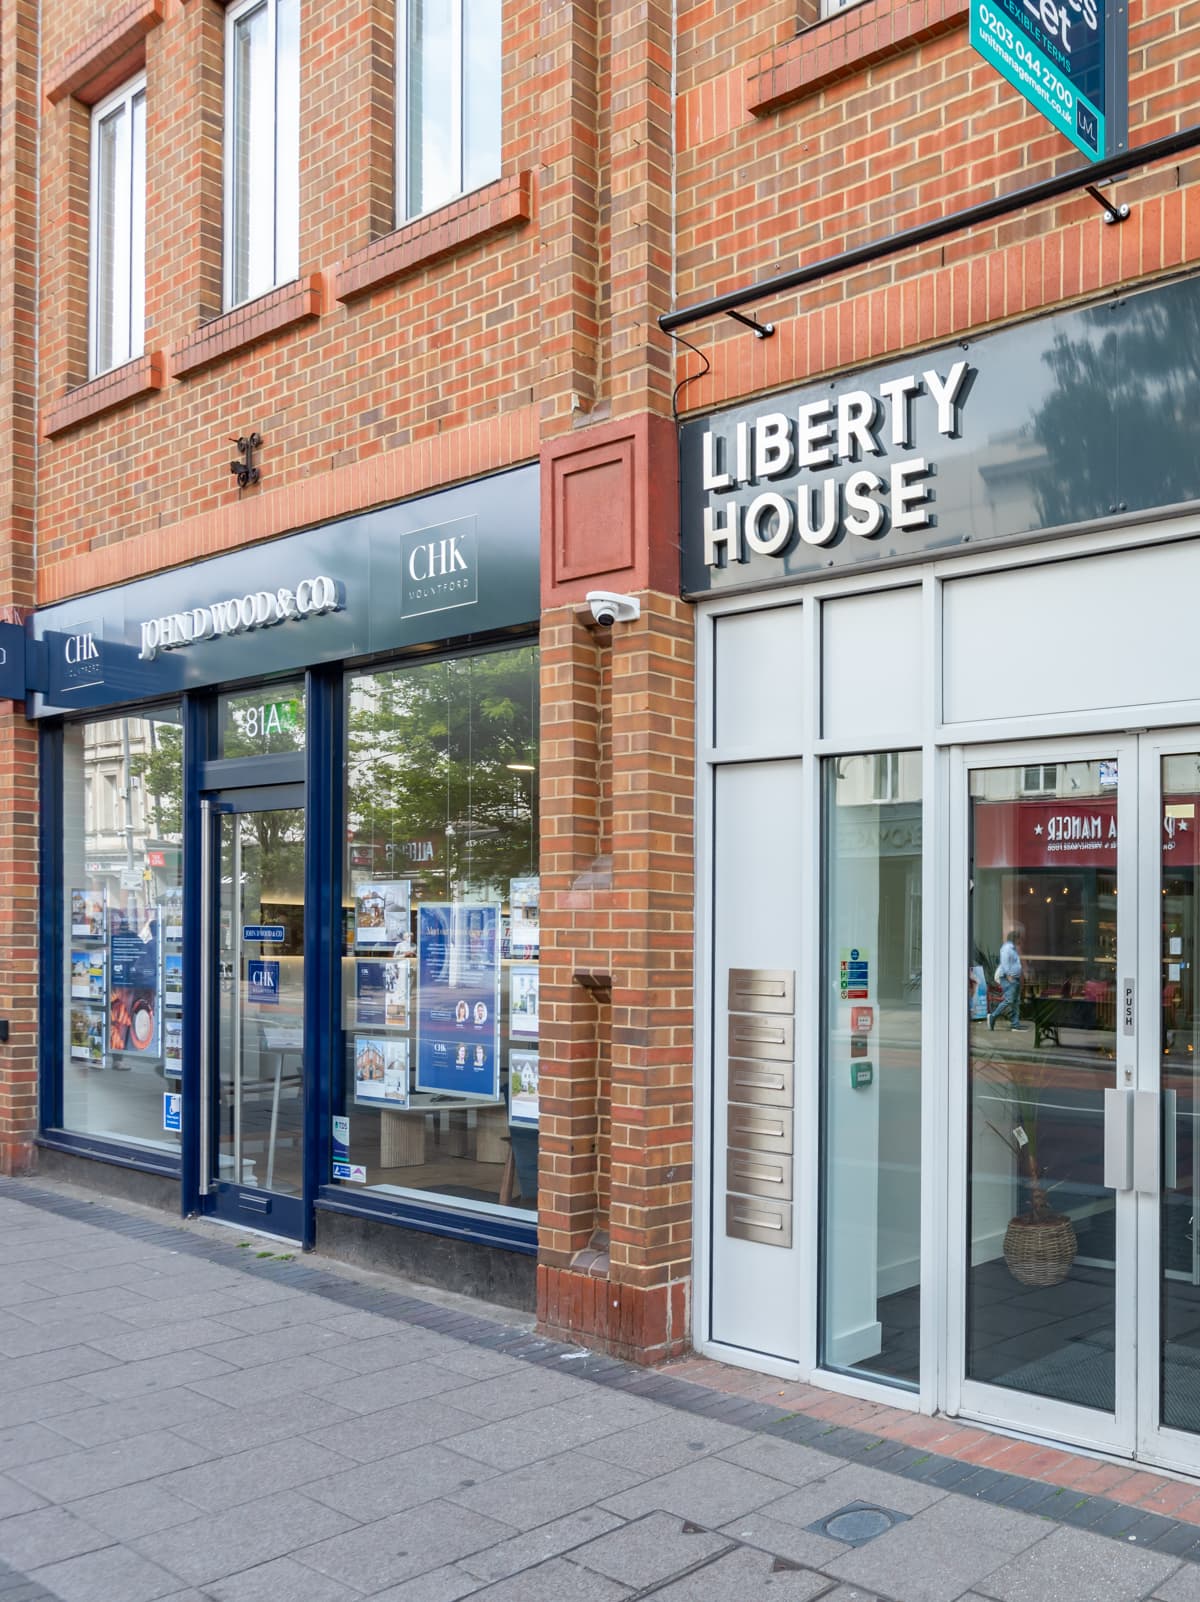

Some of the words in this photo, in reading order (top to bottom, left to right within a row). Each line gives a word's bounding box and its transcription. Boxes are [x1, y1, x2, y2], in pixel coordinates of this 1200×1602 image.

[979, 4, 1013, 49] 0203
[1015, 40, 1041, 77] 044
[1042, 67, 1073, 109] 2700
[1003, 0, 1040, 41] LEXIBLE
[1041, 34, 1071, 73] TERMS
[979, 27, 1072, 125] unitmanagement.co.uk
[702, 360, 972, 492] LIBERTY
[703, 456, 931, 567] HOUSE
[409, 535, 468, 581] CHK
[65, 632, 99, 664] CHK
[139, 611, 193, 661] JOHN
[192, 607, 215, 639] D
[209, 591, 280, 634] WOOD
[277, 587, 298, 619] &
[246, 703, 282, 737] 81A
[252, 970, 274, 986] CHK
[1125, 988, 1133, 1026] PUSH
